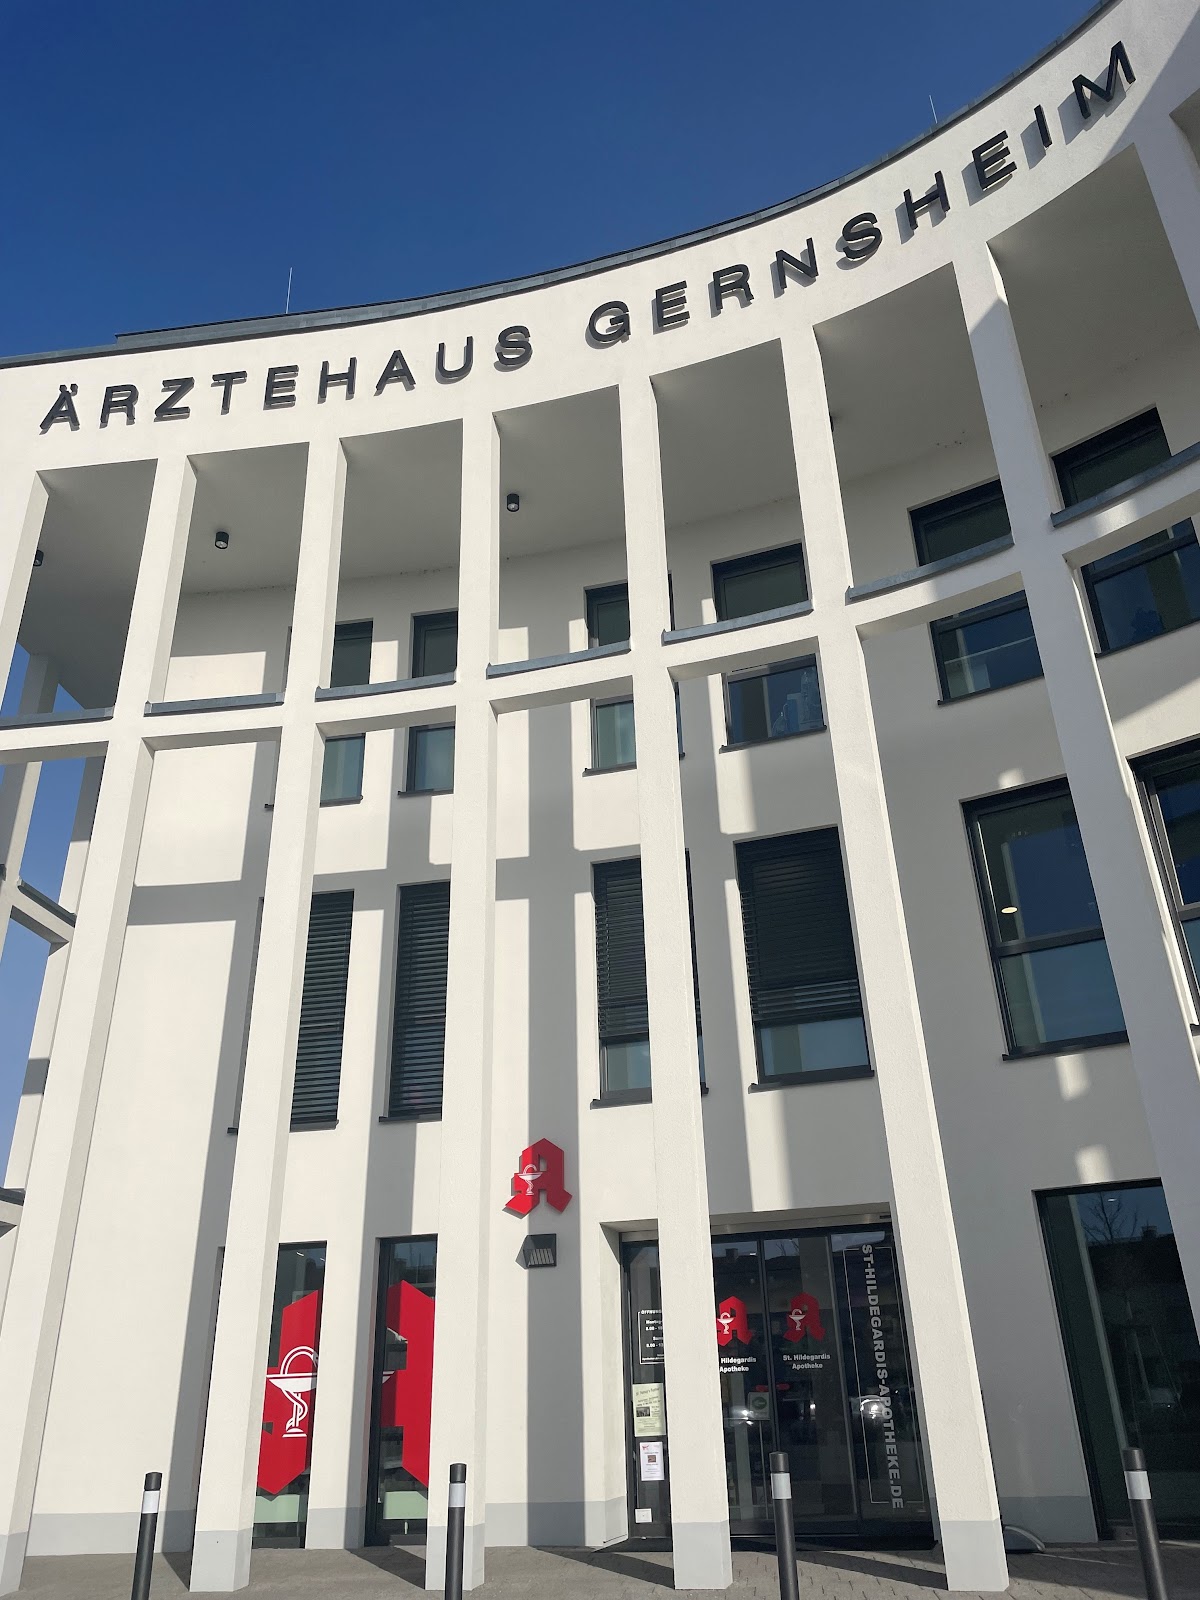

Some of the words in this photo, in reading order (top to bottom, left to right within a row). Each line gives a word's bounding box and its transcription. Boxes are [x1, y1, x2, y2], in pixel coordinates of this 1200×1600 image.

[40, 325, 534, 433] ÄRZTEHAUS
[586, 40, 1136, 346] GERNSHEIM
[720, 1356, 757, 1364] Hildegardis
[794, 1353, 831, 1361] Hildegardis
[719, 1365, 750, 1373] Apotheke
[792, 1362, 824, 1370] Apotheke
[862, 1244, 904, 1509] ST-HILDEGARDIS-APOTHEKE.DE
